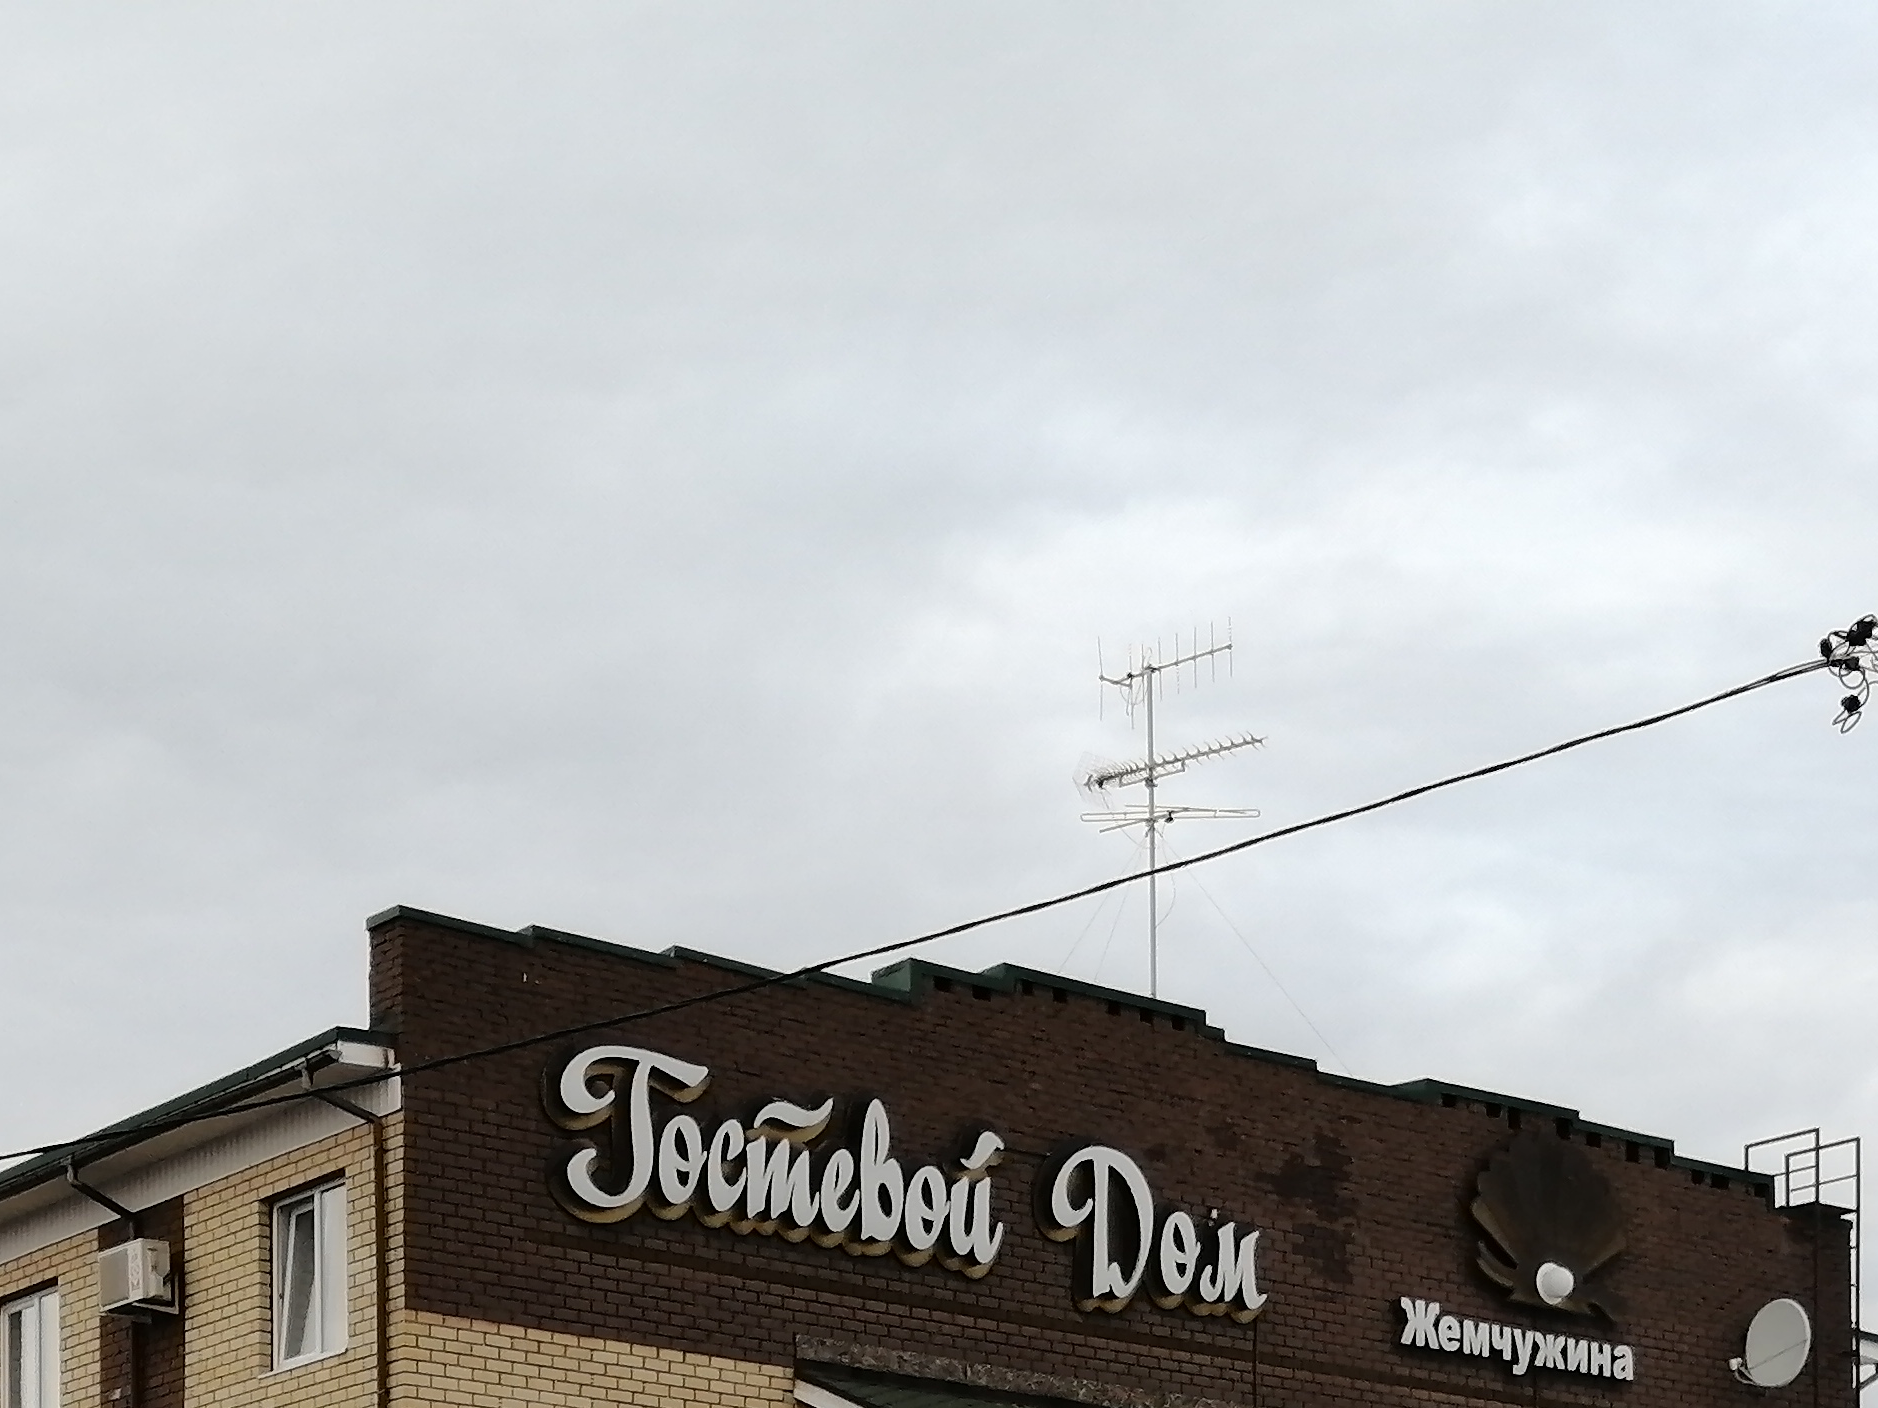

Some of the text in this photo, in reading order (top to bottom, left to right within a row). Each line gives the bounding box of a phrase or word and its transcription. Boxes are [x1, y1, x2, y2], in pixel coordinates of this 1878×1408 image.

[559, 1044, 1268, 1310] Гостевой Дом
[1399, 1296, 1635, 1382] Жемчужина
